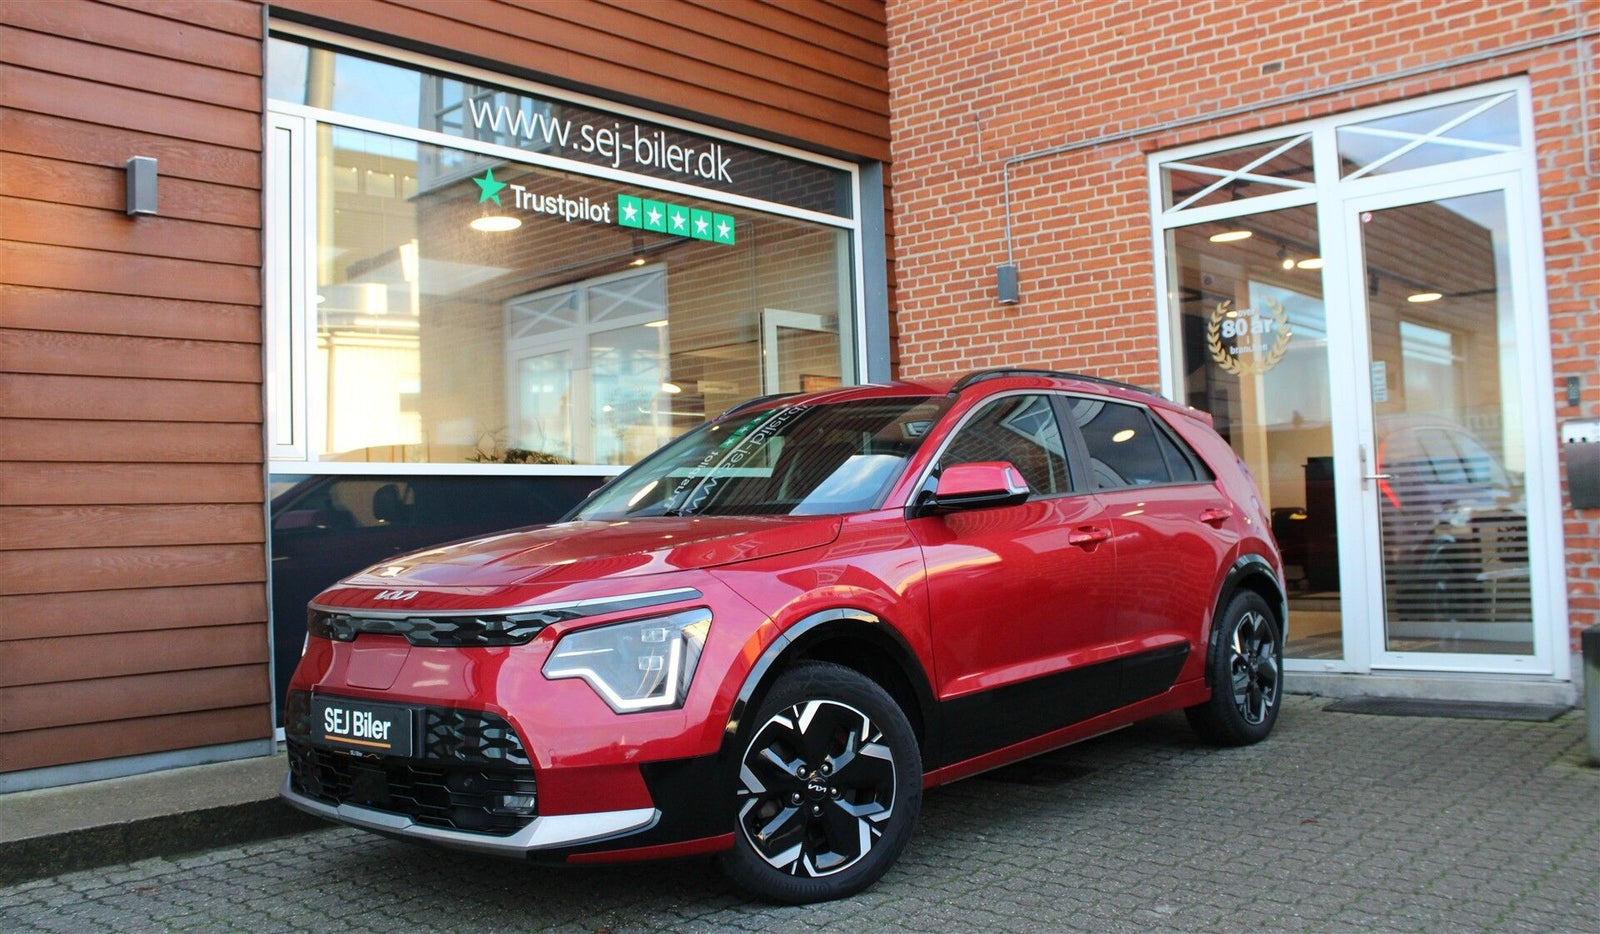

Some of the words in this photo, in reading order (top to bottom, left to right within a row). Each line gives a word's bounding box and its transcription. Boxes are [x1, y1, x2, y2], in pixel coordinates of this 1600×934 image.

[469, 98, 733, 183] www.sej-biler.dk
[510, 184, 611, 223] Trustpilot
[1221, 319, 1248, 338] 80
[374, 590, 419, 600] KIA
[324, 707, 350, 735] SEJ
[353, 710, 391, 740] Biler
